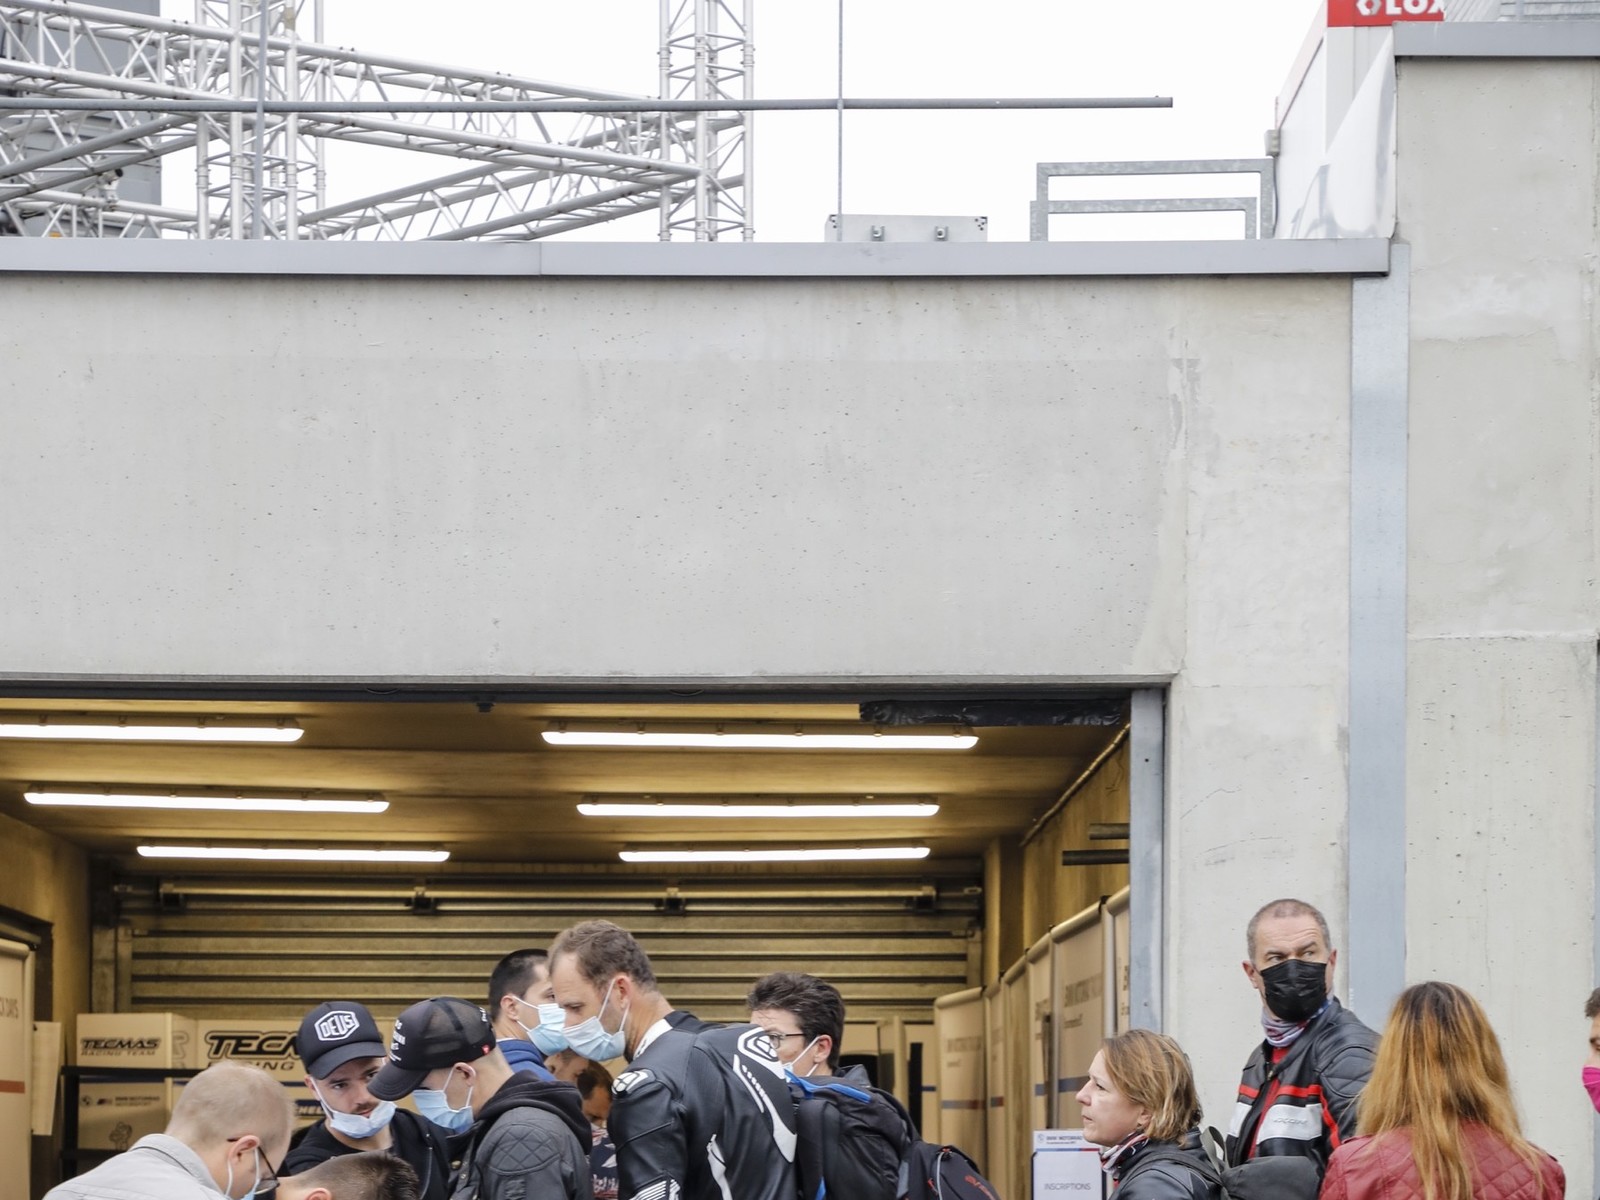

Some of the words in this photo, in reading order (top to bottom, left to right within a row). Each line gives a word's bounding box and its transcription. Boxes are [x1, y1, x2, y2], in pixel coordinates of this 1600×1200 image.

[320, 1014, 355, 1038] DEUS
[82, 1038, 160, 1050] TECMAS
[1044, 1182, 1091, 1190] INSCRIPTIONS
